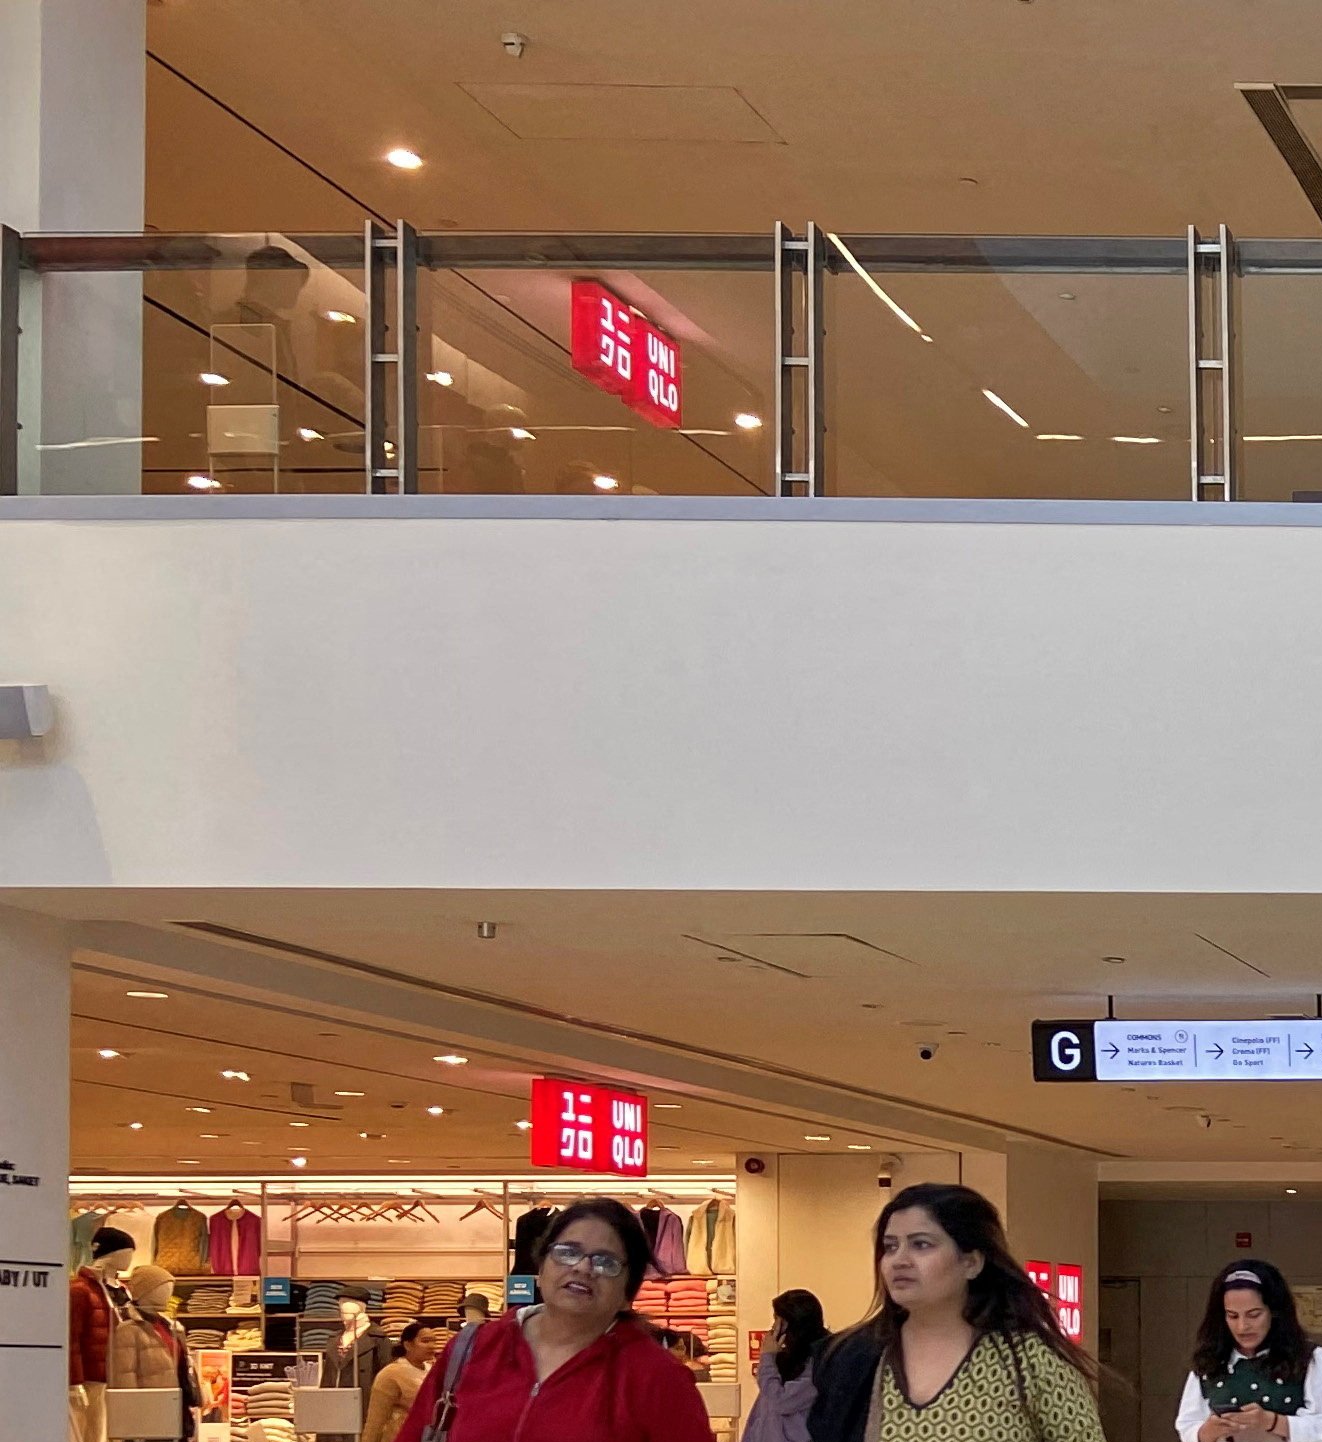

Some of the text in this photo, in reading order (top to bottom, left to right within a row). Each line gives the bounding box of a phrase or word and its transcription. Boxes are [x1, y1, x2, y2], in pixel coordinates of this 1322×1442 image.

[648, 332, 675, 379] UNI
[648, 368, 679, 412] QLO
[1051, 1031, 1081, 1070] G
[1158, 1047, 1187, 1055] Spencer
[612, 1099, 642, 1133] UNI
[612, 1134, 644, 1168] QLO
[1058, 1274, 1079, 1303] UNI
